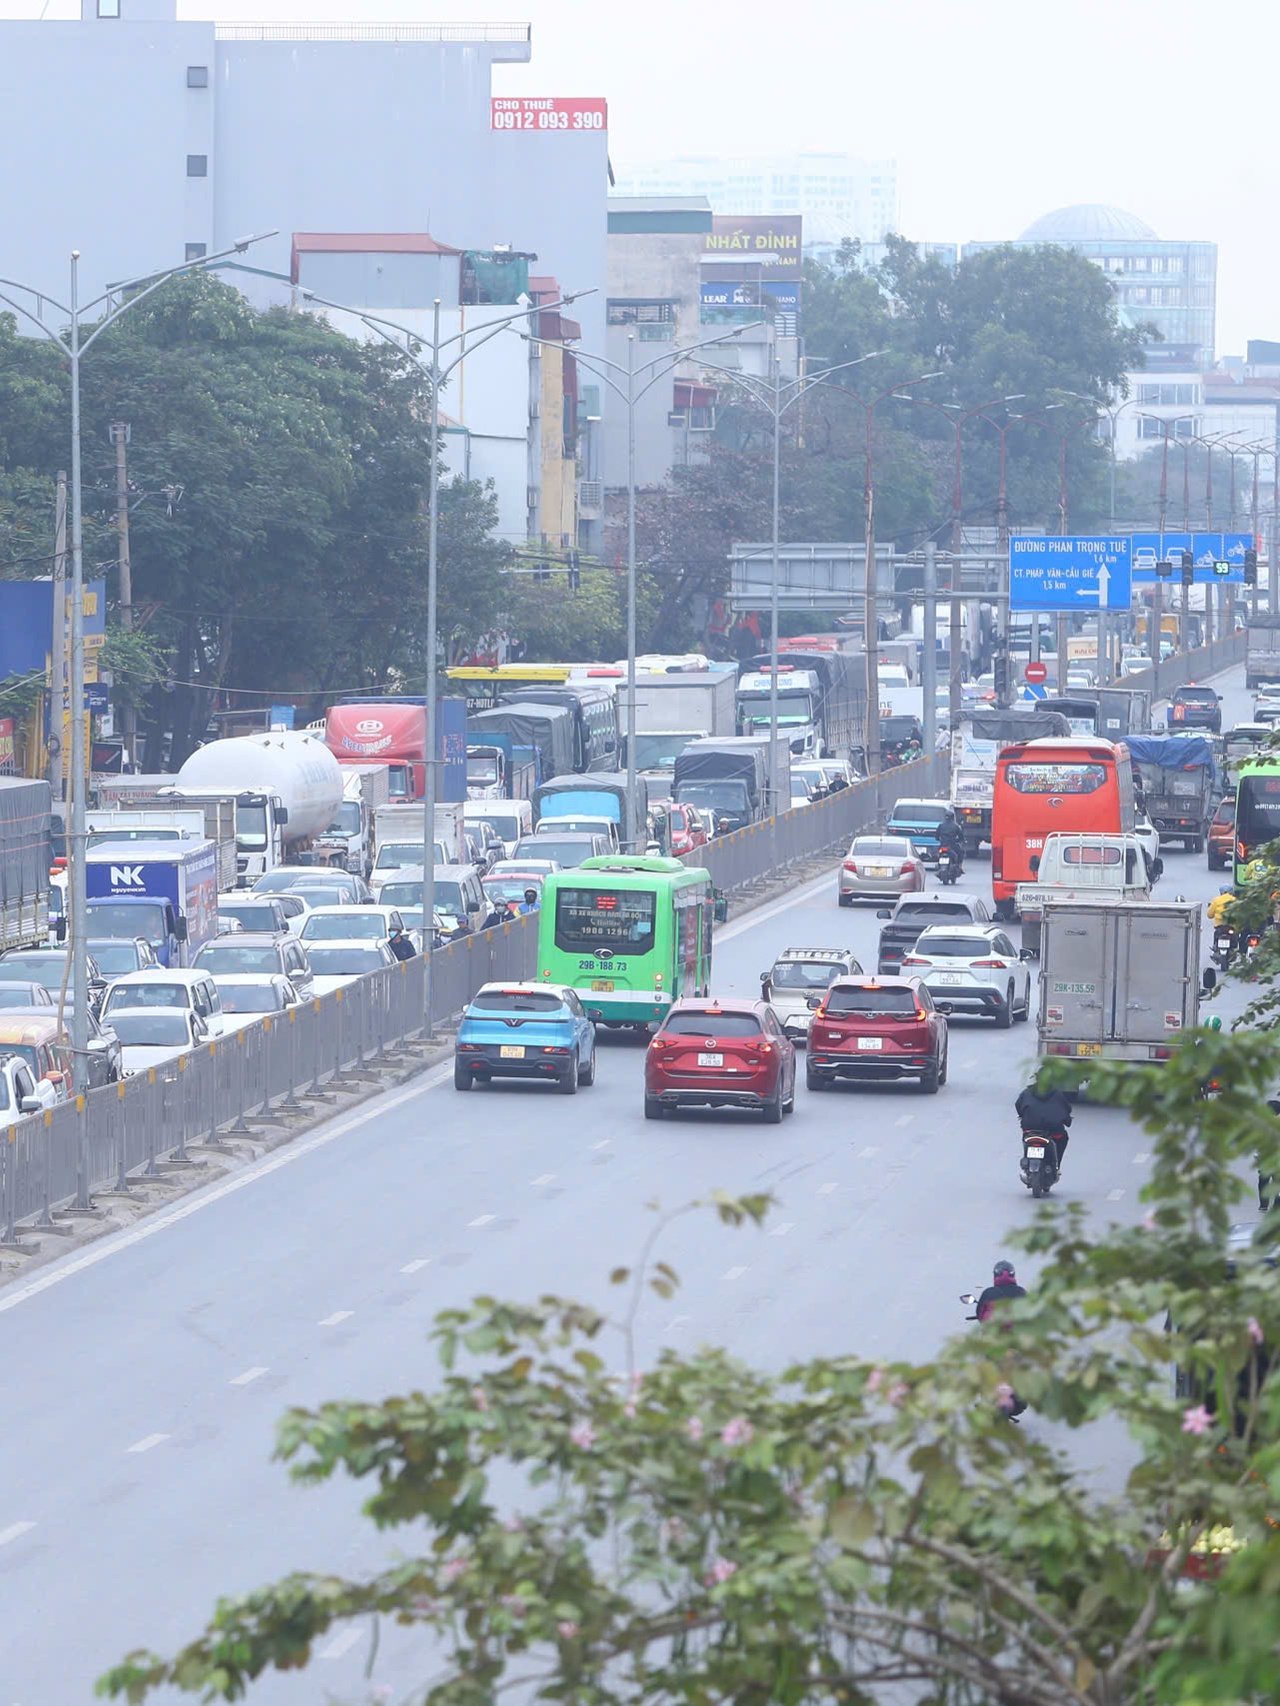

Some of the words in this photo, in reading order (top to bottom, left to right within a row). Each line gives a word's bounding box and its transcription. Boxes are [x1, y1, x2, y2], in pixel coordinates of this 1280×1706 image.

[495, 100, 520, 110] CHO
[523, 98, 554, 110] THUÊ
[495, 111, 534, 129] 0912
[539, 111, 568, 129] 093
[573, 111, 603, 129] 390
[1014, 540, 1046, 553] ĐƯỜNG
[1048, 541, 1073, 553] PHAN
[1076, 541, 1106, 555] TRỌNG
[1105, 554, 1117, 563] km
[1215, 562, 1229, 574] 59
[1054, 580, 1067, 590] km
[111, 865, 145, 886] NK
